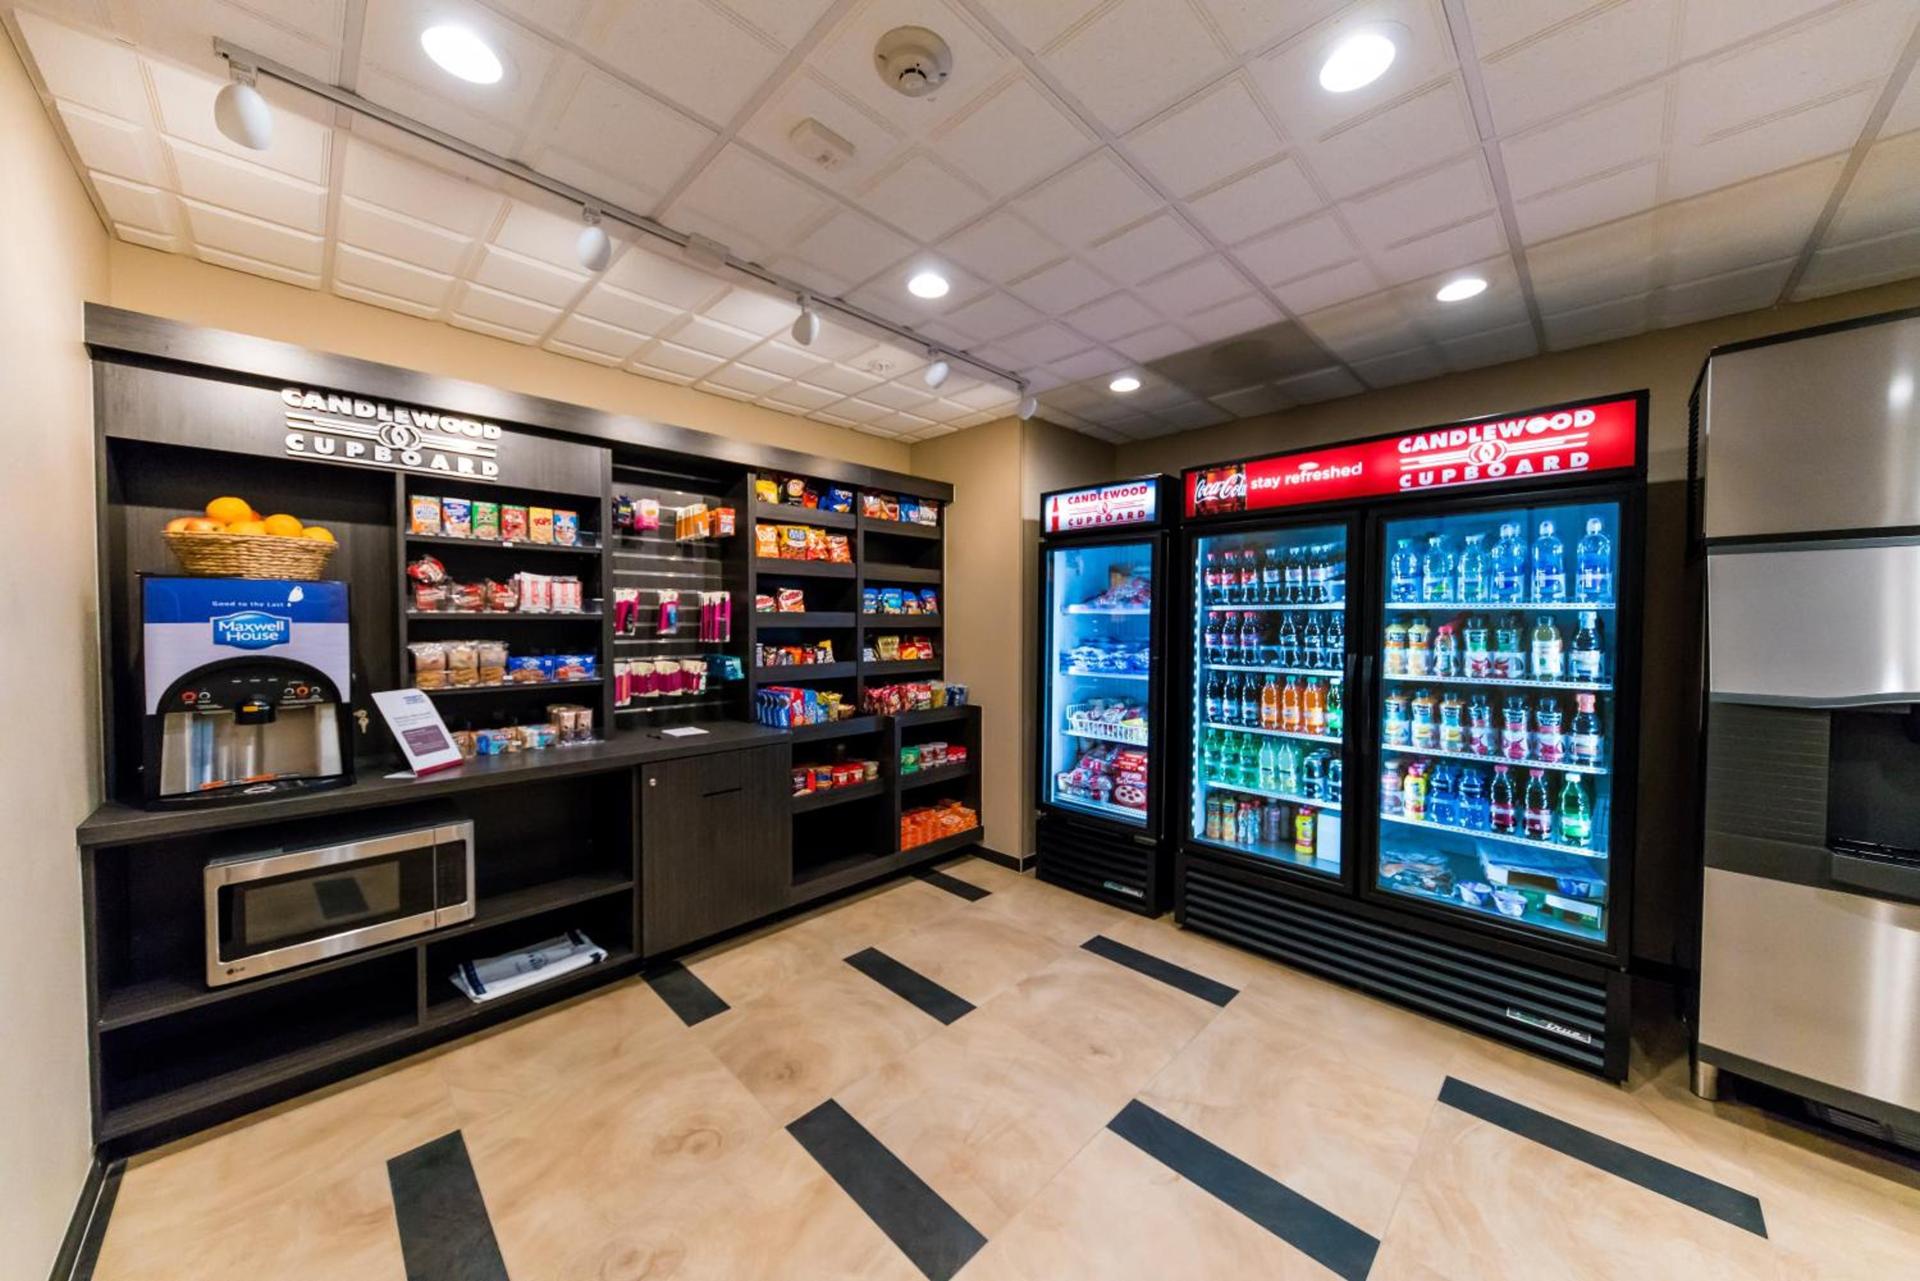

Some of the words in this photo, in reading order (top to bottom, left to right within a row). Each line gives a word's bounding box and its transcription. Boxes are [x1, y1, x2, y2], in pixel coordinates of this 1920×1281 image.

[281, 388, 502, 440] CANDLEWOOD
[1398, 409, 1596, 453] CANDLEWOOD
[285, 433, 499, 477] CUPBOARD
[1399, 452, 1590, 488] CUPBOARD
[1194, 473, 1248, 504] Coca-Cola
[1251, 476, 1281, 491] stay
[1285, 461, 1363, 486] refreshed
[1068, 485, 1148, 505] CANDLEWOOD
[1068, 510, 1146, 527] CUPBOARD
[218, 620, 285, 633] Maxwell
[226, 631, 280, 642] House
